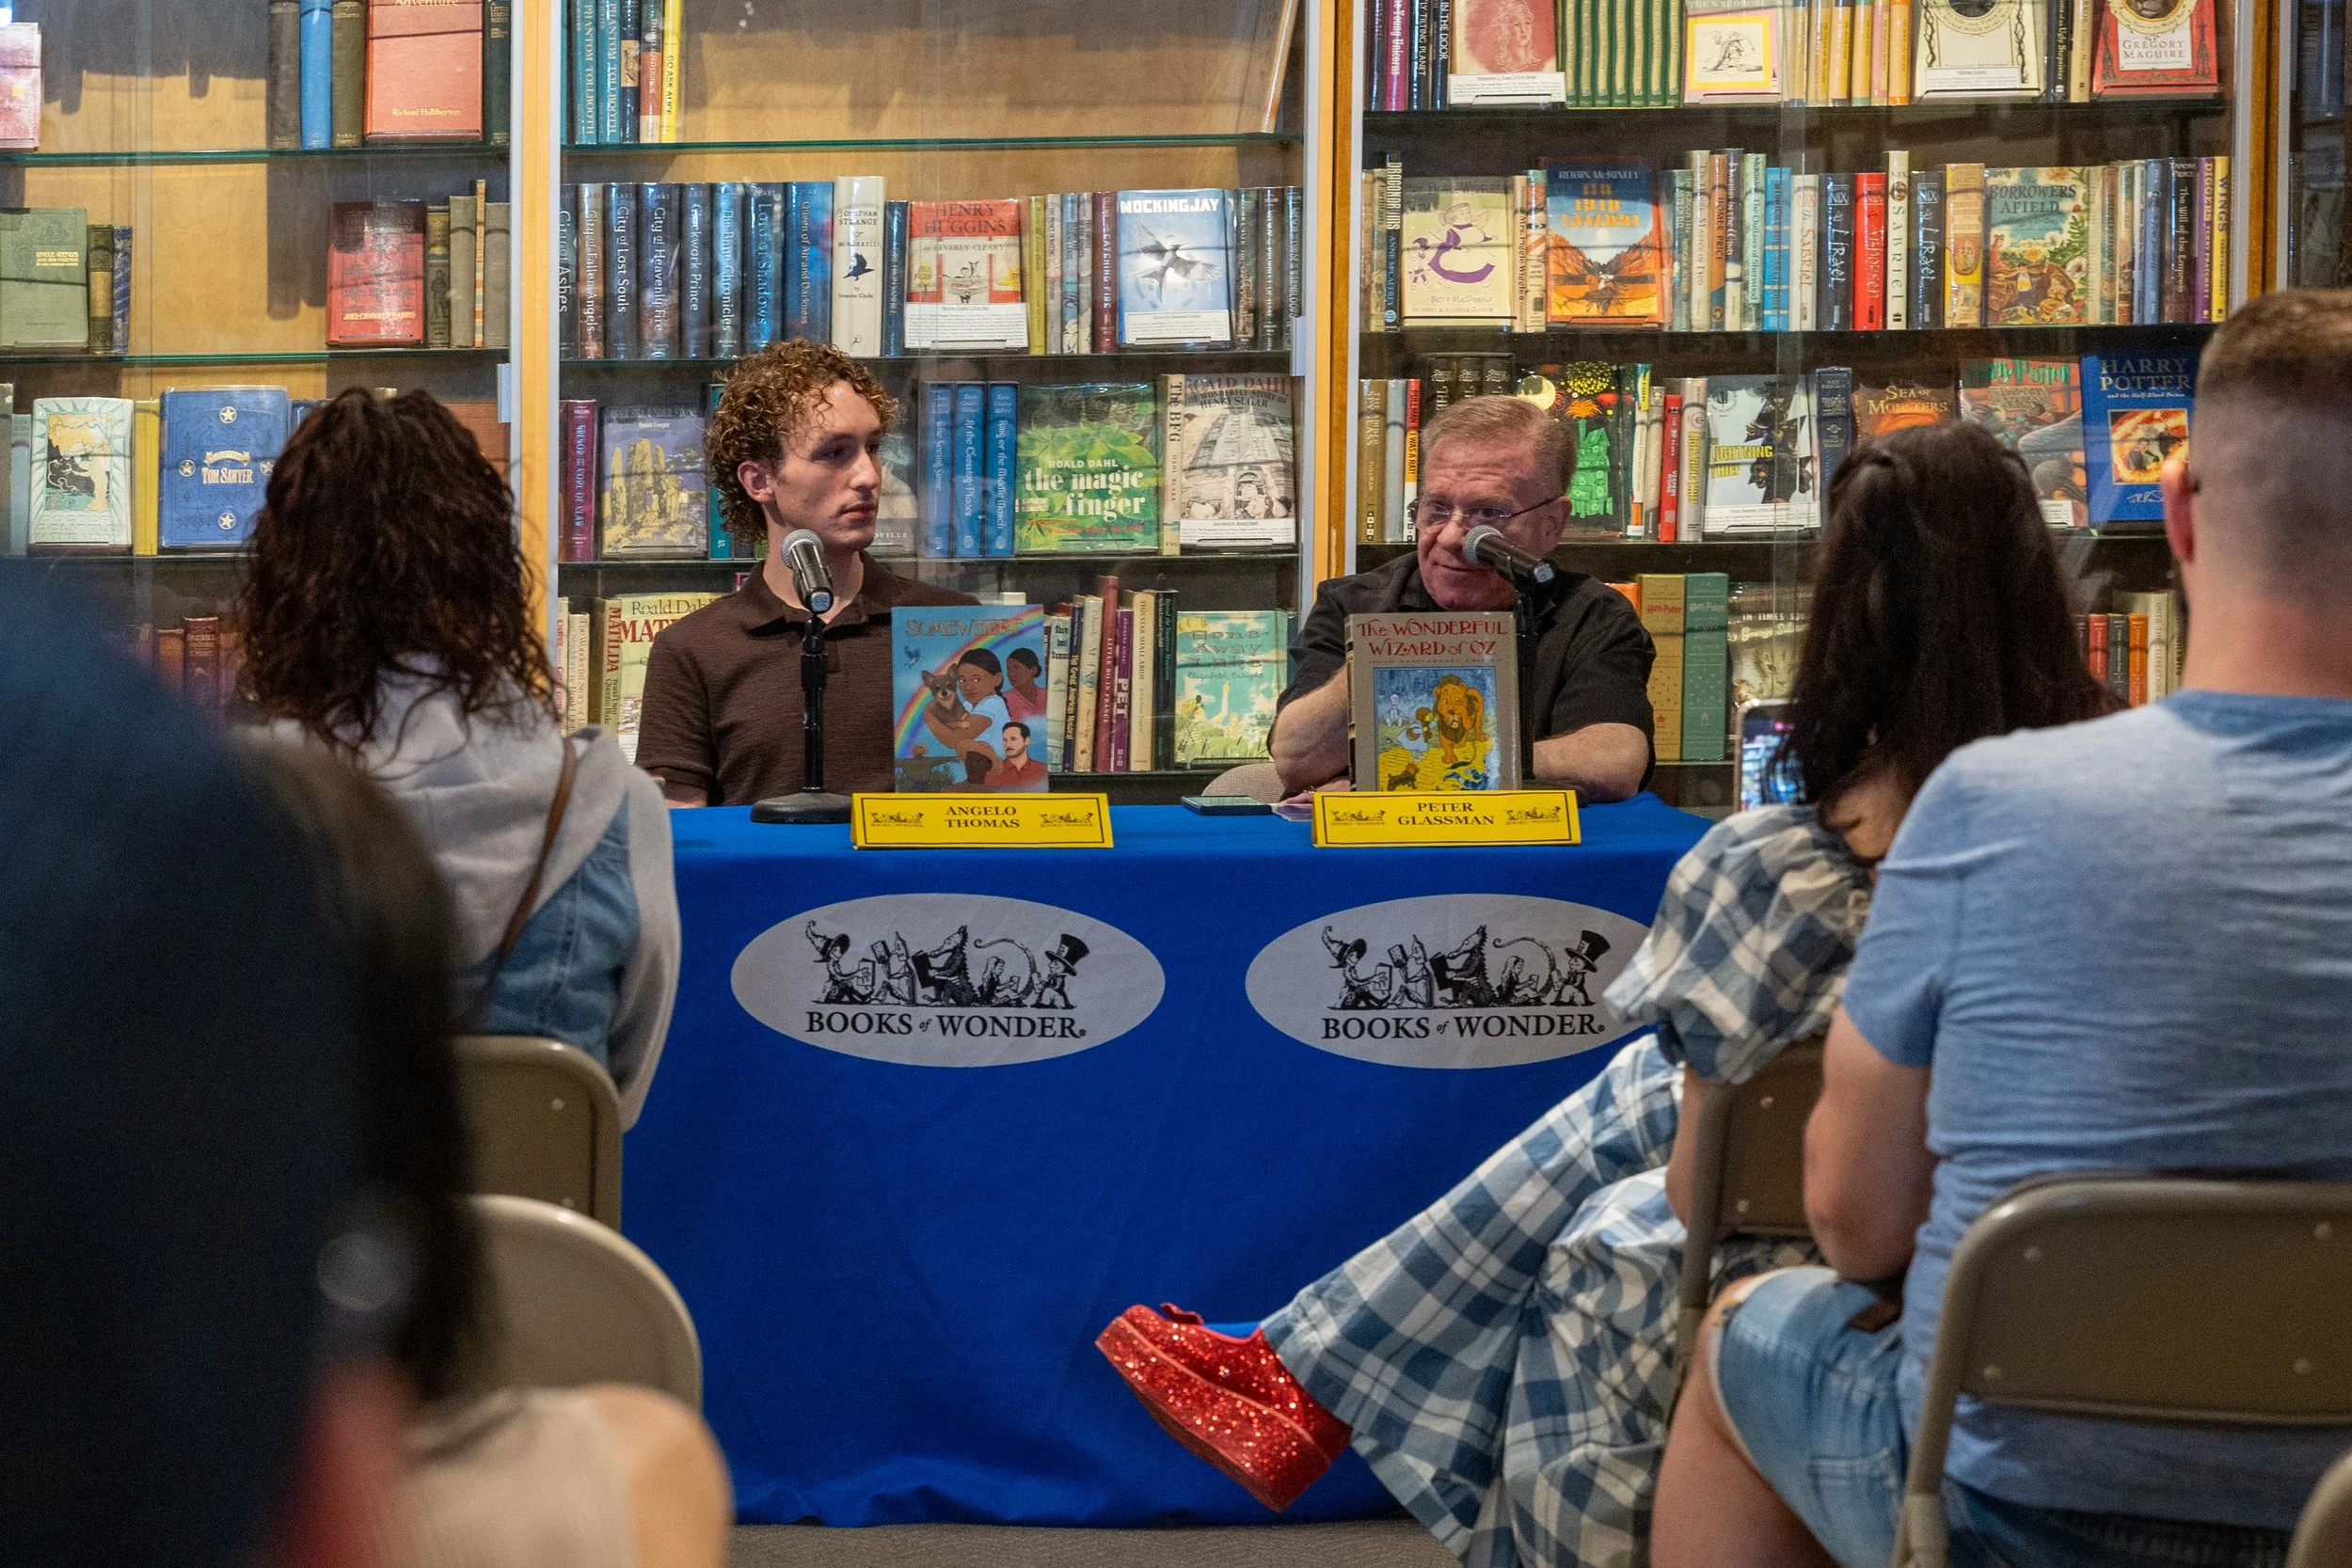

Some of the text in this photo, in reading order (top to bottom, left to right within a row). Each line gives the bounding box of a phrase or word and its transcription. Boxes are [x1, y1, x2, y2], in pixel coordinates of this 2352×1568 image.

[1419, 13, 1427, 43] TILTING
[1439, 2, 1449, 60] IN THE DOOR
[1391, 10, 1405, 75] Young Unicorns
[2122, 40, 2185, 50] GREGORY
[666, 55, 675, 69] GO
[2057, 27, 2067, 80] Ugly Stepsister
[2123, 50, 2185, 59] MAGUIRE
[585, 5, 595, 134] PHANTOM TOLLBOOTH
[609, 3, 617, 133] PHANTOM TOLLBOOTH
[1387, 162, 1403, 230] DRAGONDRUMS
[1990, 184, 2076, 198] BORROWERS
[2180, 187, 2188, 203] The
[2203, 163, 2212, 220] DIGGERS
[934, 203, 994, 216] HENRY
[1120, 198, 1219, 214] MOCKINGJAY
[2000, 200, 2059, 214] AFIELD
[2217, 176, 2229, 231] WINGS
[583, 211, 596, 235] City
[1716, 198, 1724, 230] HOMER
[2179, 206, 2188, 223] Will
[925, 221, 1007, 234] HUGGINS
[2177, 225, 2187, 234] of
[1892, 206, 1905, 300] SABRIEL
[2179, 237, 2187, 251] the
[614, 207, 629, 312] City of Lost Souls
[1752, 249, 1759, 258] of
[585, 252, 597, 288] Fallen
[651, 208, 666, 331] City of Heavenly Fire
[722, 210, 734, 330] The Chronicles
[757, 204, 771, 325] Lord Shadows
[1103, 233, 1112, 309] CATCHING FIRE
[1751, 261, 1759, 301] Sherwood
[2177, 255, 2187, 293] Empress
[560, 267, 570, 312] Ashes
[690, 274, 702, 311] Prince
[583, 291, 597, 331] Angels
[802, 281, 811, 324] Darkness
[2100, 358, 2186, 373] HARRY
[1245, 377, 1286, 395] DAHL
[2100, 375, 2191, 391] POTTER
[1200, 389, 1288, 404] WONDERFUL STORY OF
[1200, 397, 1268, 408] HENRY SUGAR
[1885, 386, 1916, 401] SEA
[1168, 382, 1183, 442] The BFG
[1409, 389, 1418, 423] PULLMAN
[1867, 400, 1948, 415] MONSTERS
[966, 431, 976, 444] the
[996, 420, 1008, 438] King
[1670, 428, 1677, 438] 39
[1408, 436, 1417, 451] WAS
[997, 452, 1008, 465] the
[1049, 458, 1119, 468] ROALD DAHL
[1688, 432, 1701, 480] LIGHTNING
[1710, 446, 1774, 463] LIGHTNING
[201, 467, 254, 483] TOM SAWYER
[1407, 460, 1416, 474] RAT!
[1710, 465, 1740, 479] THIEF
[997, 467, 1008, 498] Middle
[1025, 467, 1145, 495] the magic
[997, 499, 1008, 529] March
[1065, 493, 1145, 521] finger
[36, 523, 119, 531] DOLITTLE
[631, 600, 672, 615] Roald
[1758, 612, 1785, 621] TIMES
[906, 619, 1024, 637] SOMEWHERE
[1357, 618, 1507, 637] The WONDERFUL
[607, 608, 622, 673] MATILDA
[1196, 643, 1263, 655] Away
[1368, 639, 1497, 656] WIZARD of OZ
[1192, 657, 1262, 667] Lake
[1105, 668, 1112, 679] BO
[1232, 672, 1263, 680] Enright
[578, 682, 586, 705] Story
[1105, 682, 1111, 690] IN
[1066, 655, 1079, 740] The Great American Mousical
[1117, 678, 1129, 718] PET
[1103, 693, 1111, 724] FRANCE
[946, 806, 1017, 816] ANGELO
[1418, 802, 1473, 812] PETER
[945, 818, 1020, 829] THOMAS
[1397, 816, 1495, 826] GLASSMAN
[804, 1010, 913, 1036] BOOKS
[918, 1018, 933, 1034] of
[1321, 1017, 1431, 1040] BOOKS
[1436, 1020, 1450, 1035] of
